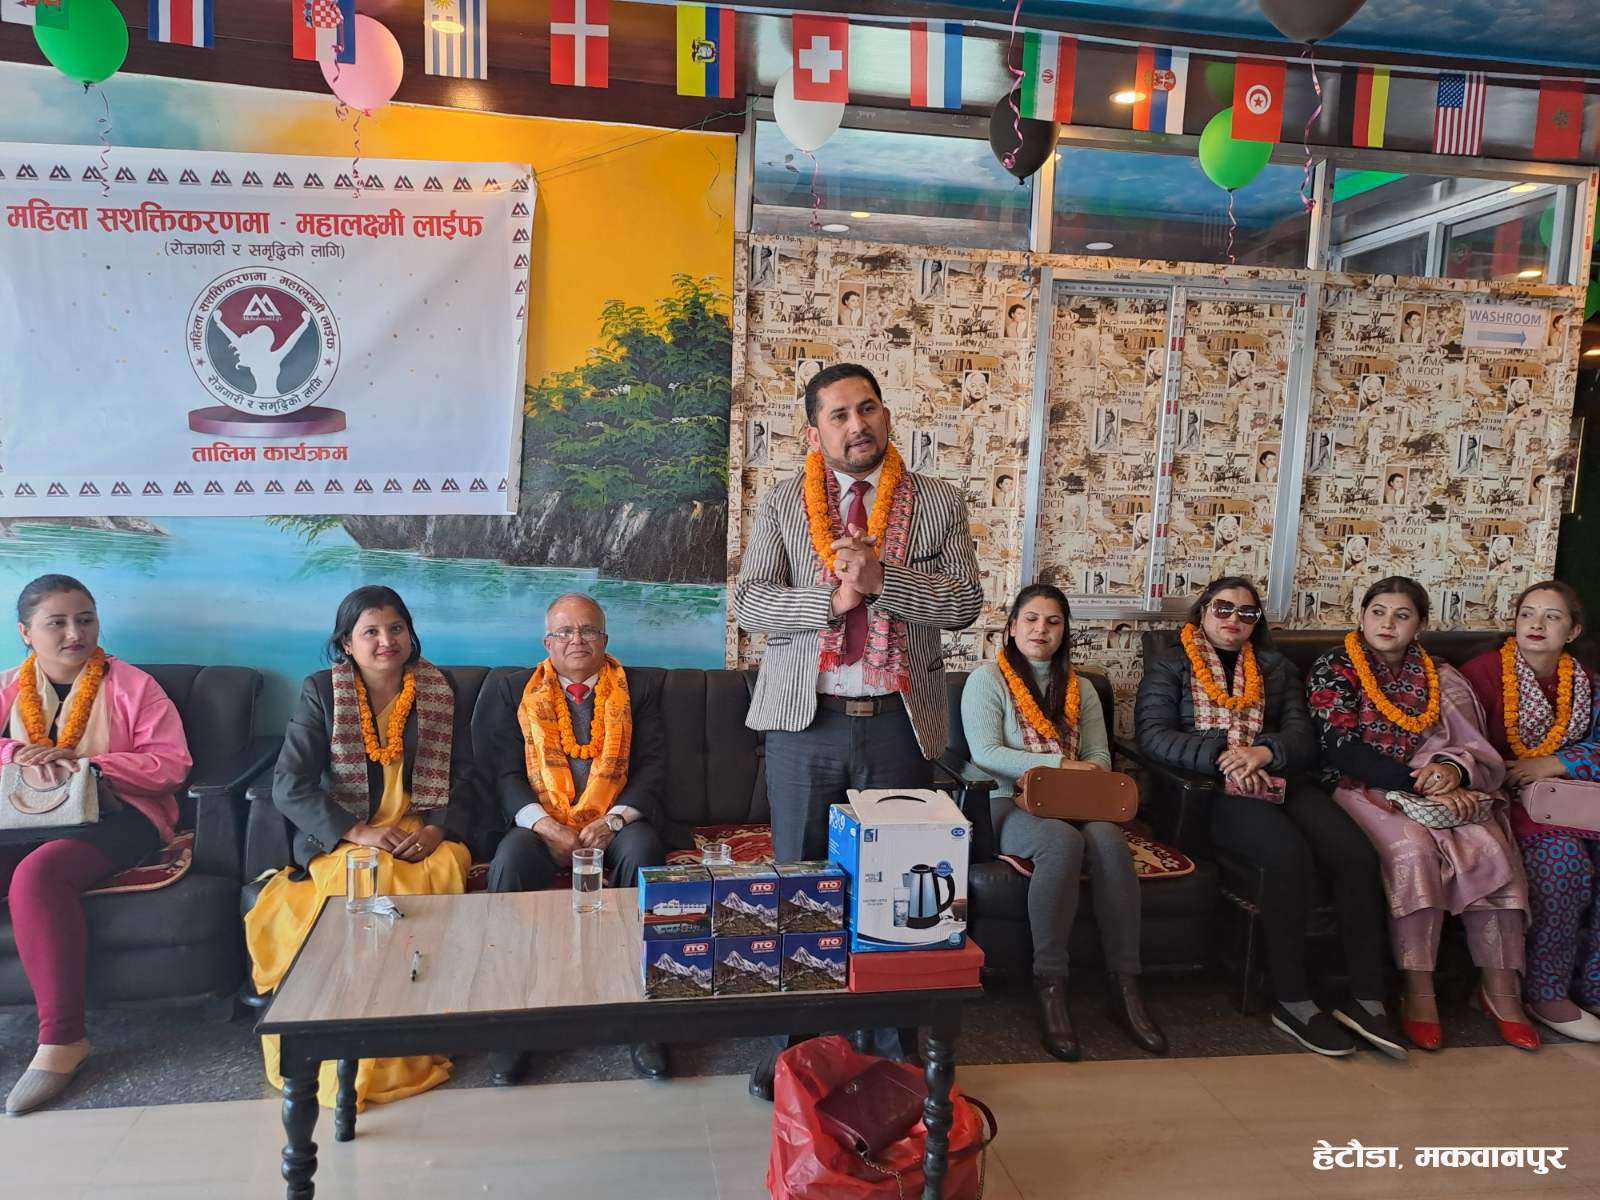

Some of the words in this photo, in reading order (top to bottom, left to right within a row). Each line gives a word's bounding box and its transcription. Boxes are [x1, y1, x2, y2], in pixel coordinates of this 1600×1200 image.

[7, 198, 88, 230] महिला
[97, 202, 269, 234] सशक्तिकरणमा
[295, 208, 405, 238] महालक्ष्मी
[412, 209, 483, 240] लाईफ
[164, 239, 226, 256] (रोजगारी
[232, 243, 242, 256] र
[248, 241, 304, 261] समृद्धिको
[311, 241, 345, 260] लागि)
[1469, 309, 1542, 326] WASHROOM
[192, 441, 256, 463] तालिम
[263, 443, 348, 462] कार्यक्रम
